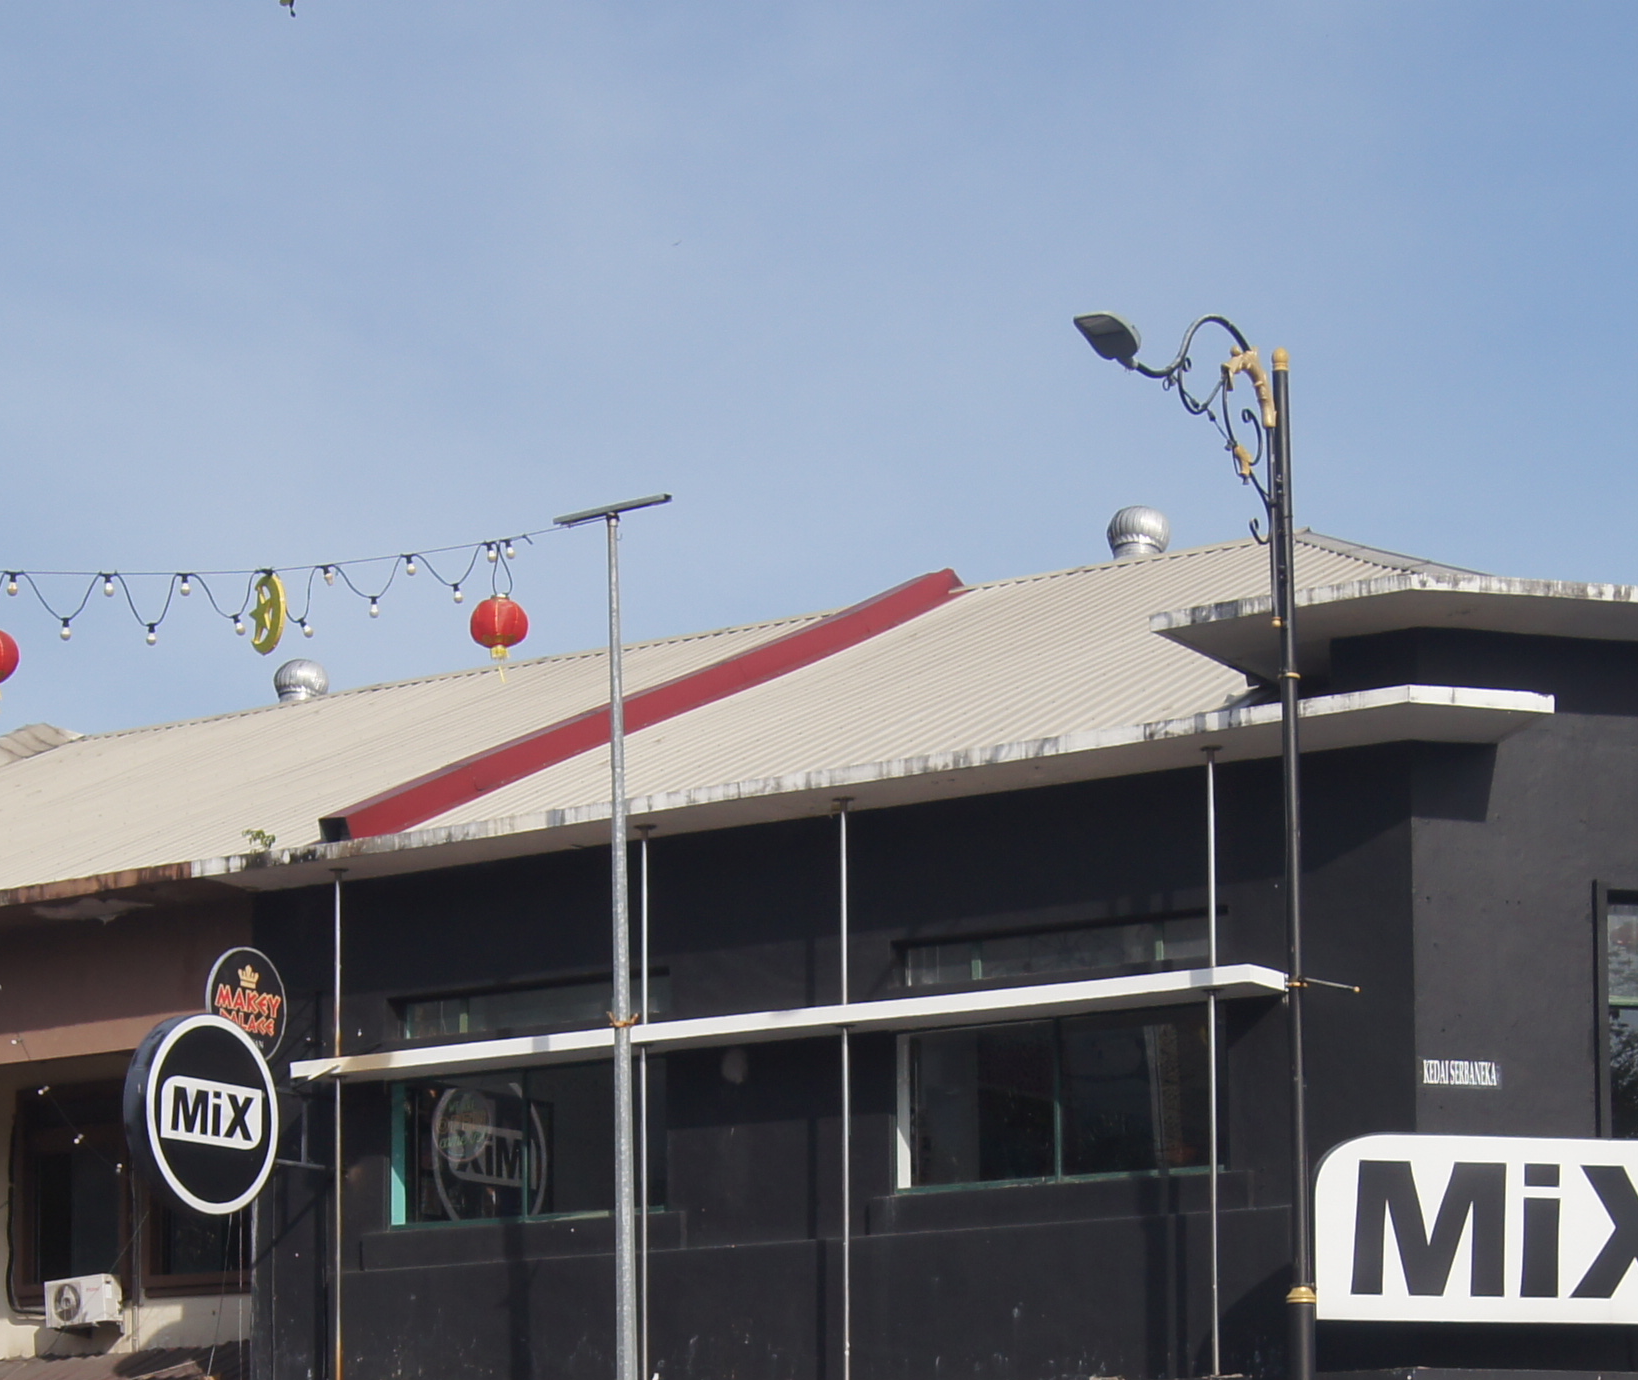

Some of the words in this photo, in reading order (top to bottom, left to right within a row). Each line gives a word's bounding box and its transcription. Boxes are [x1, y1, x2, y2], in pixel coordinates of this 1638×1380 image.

[215, 983, 281, 1018] MAKEY
[1423, 1059, 1449, 1085] KEDAI
[1450, 1060, 1497, 1086] SERBANEKA
[170, 1085, 255, 1142] MiX
